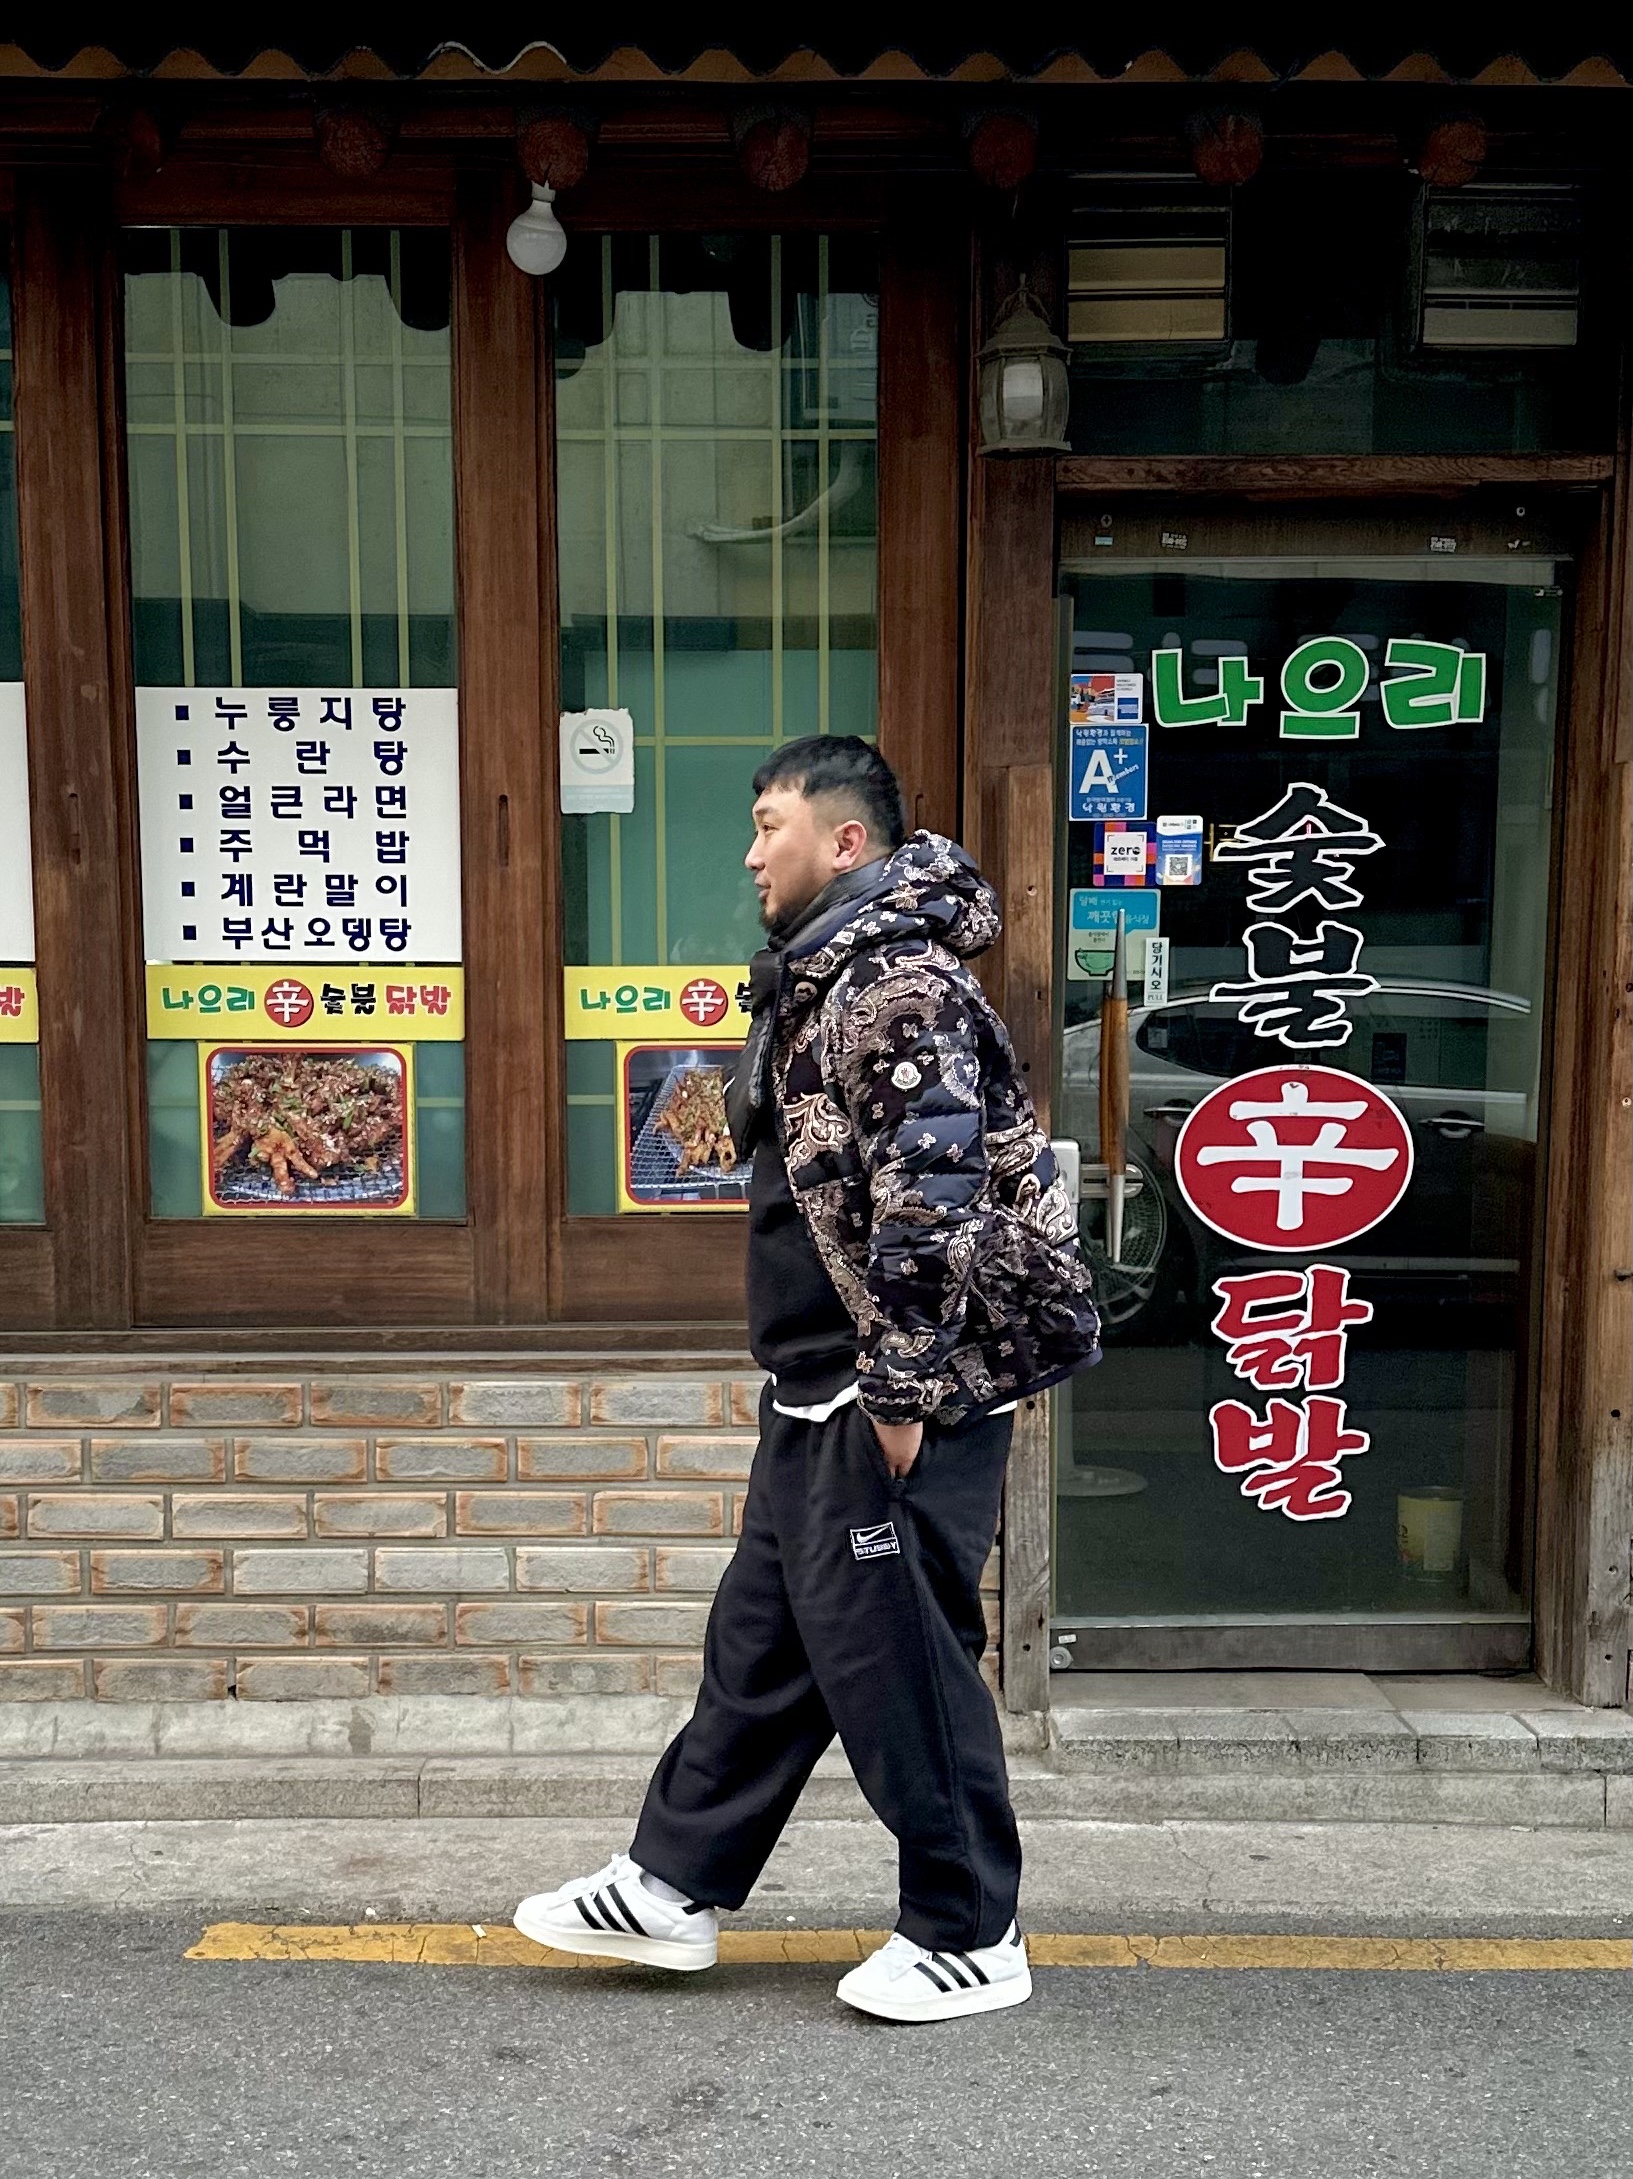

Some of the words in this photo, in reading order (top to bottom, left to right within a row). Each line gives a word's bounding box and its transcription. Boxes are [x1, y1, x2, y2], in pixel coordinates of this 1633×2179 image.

[1152, 637, 1486, 739] 나으리
[215, 697, 406, 731] 누룽지탕
[217, 741, 408, 775] 수란탕
[219, 786, 407, 819] 얼큰라면
[219, 830, 410, 863] 주먹밥
[1110, 846, 1141, 856] zero
[221, 874, 408, 907] 계란말이
[1208, 781, 1386, 1049] 숯불
[222, 918, 412, 951] 부산오뎅탕
[1151, 941, 1163, 990] 당기시오
[162, 985, 255, 1014] 나으리
[266, 981, 310, 1023] 辛
[385, 985, 451, 1015] 닭발
[580, 985, 671, 1014] 나으리
[682, 980, 724, 1022] 辛
[1197, 1081, 1399, 1231] 辛
[1209, 1263, 1375, 1522] 닭발
